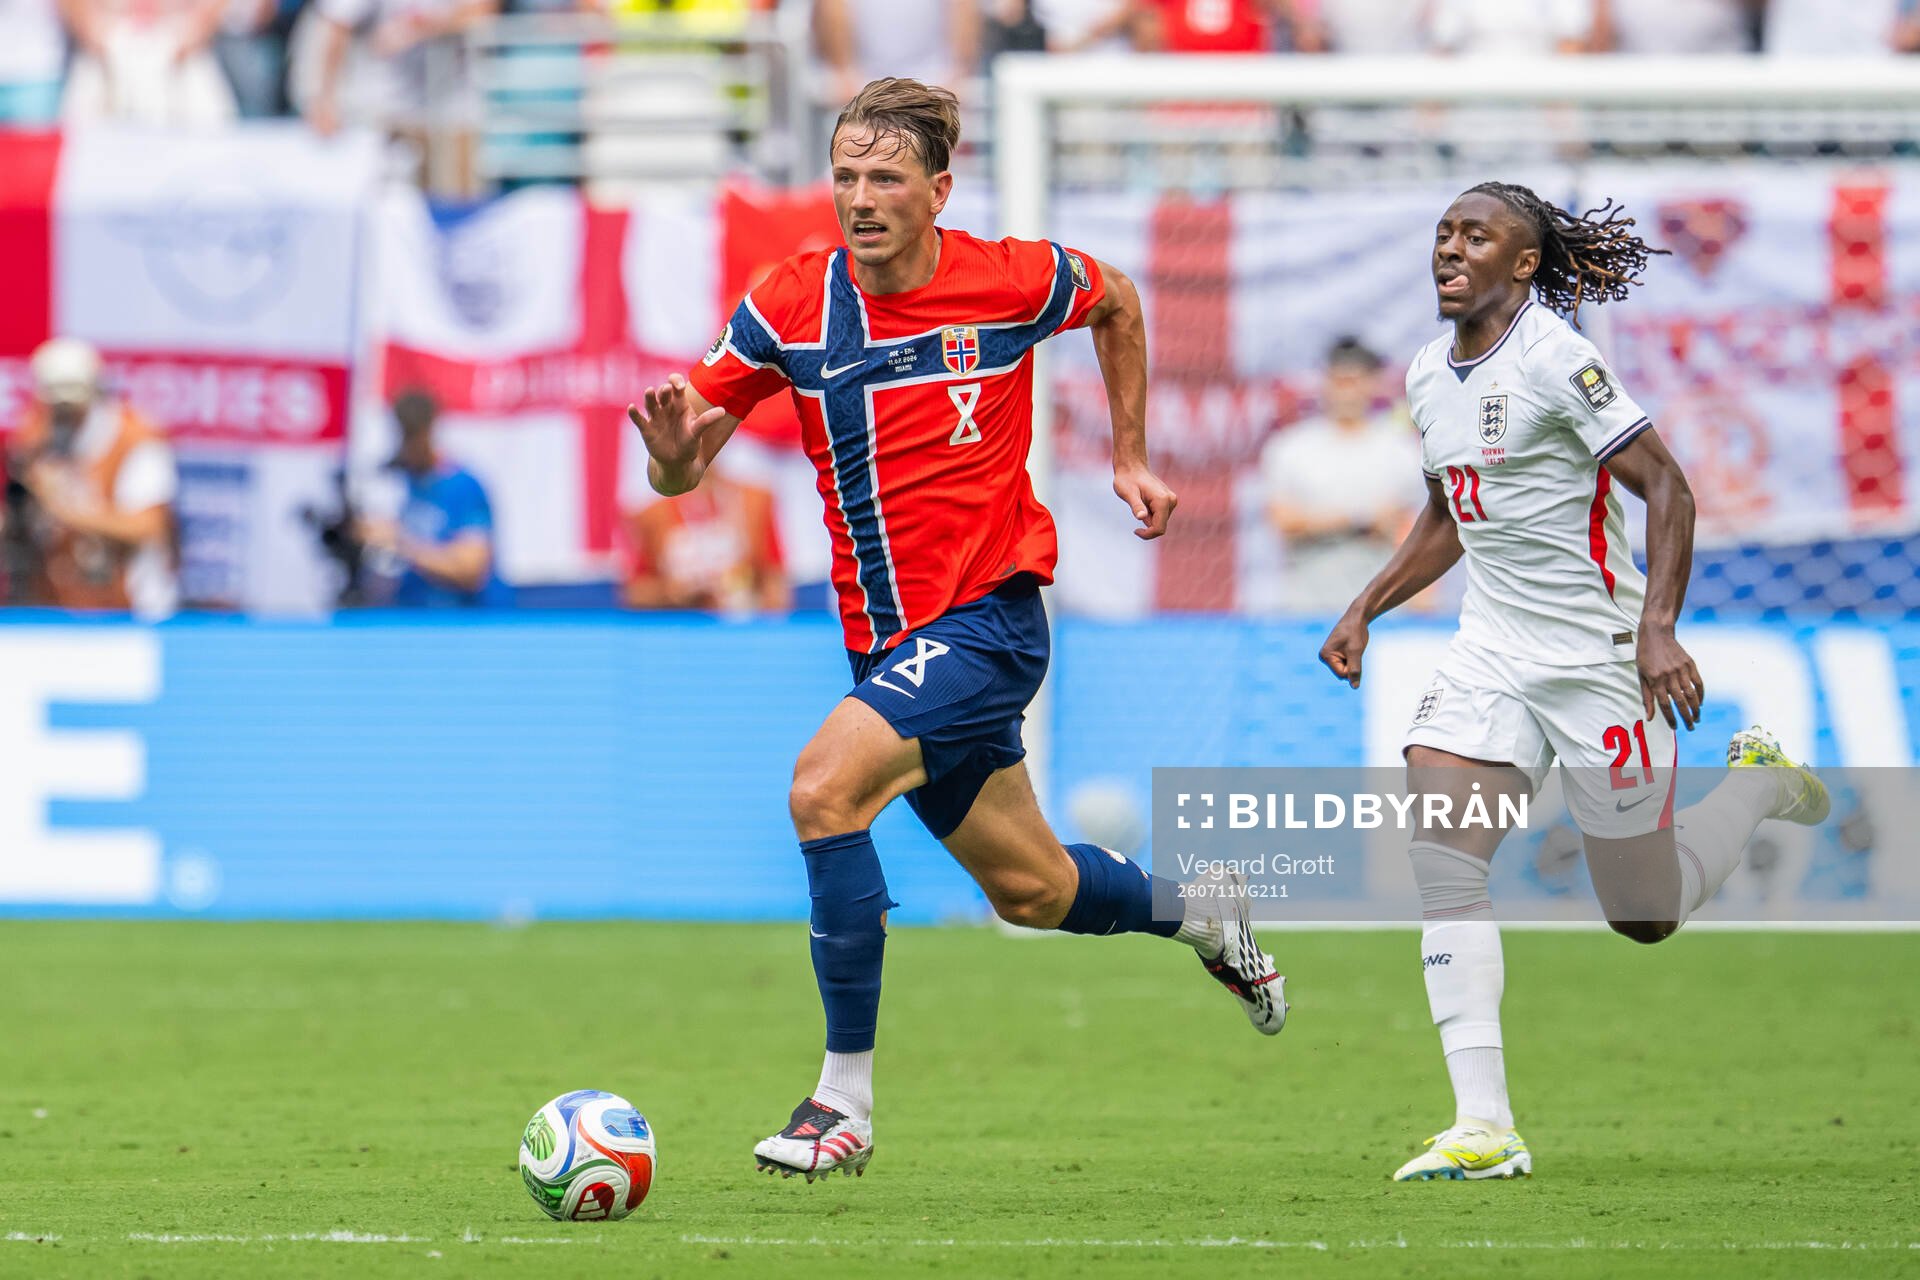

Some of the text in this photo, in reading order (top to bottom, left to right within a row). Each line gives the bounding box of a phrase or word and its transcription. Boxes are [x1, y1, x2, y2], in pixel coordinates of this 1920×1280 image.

[947, 382, 982, 446] 8
[1446, 464, 1489, 523] 21
[891, 637, 951, 688] 8
[1601, 719, 1655, 791] 21
